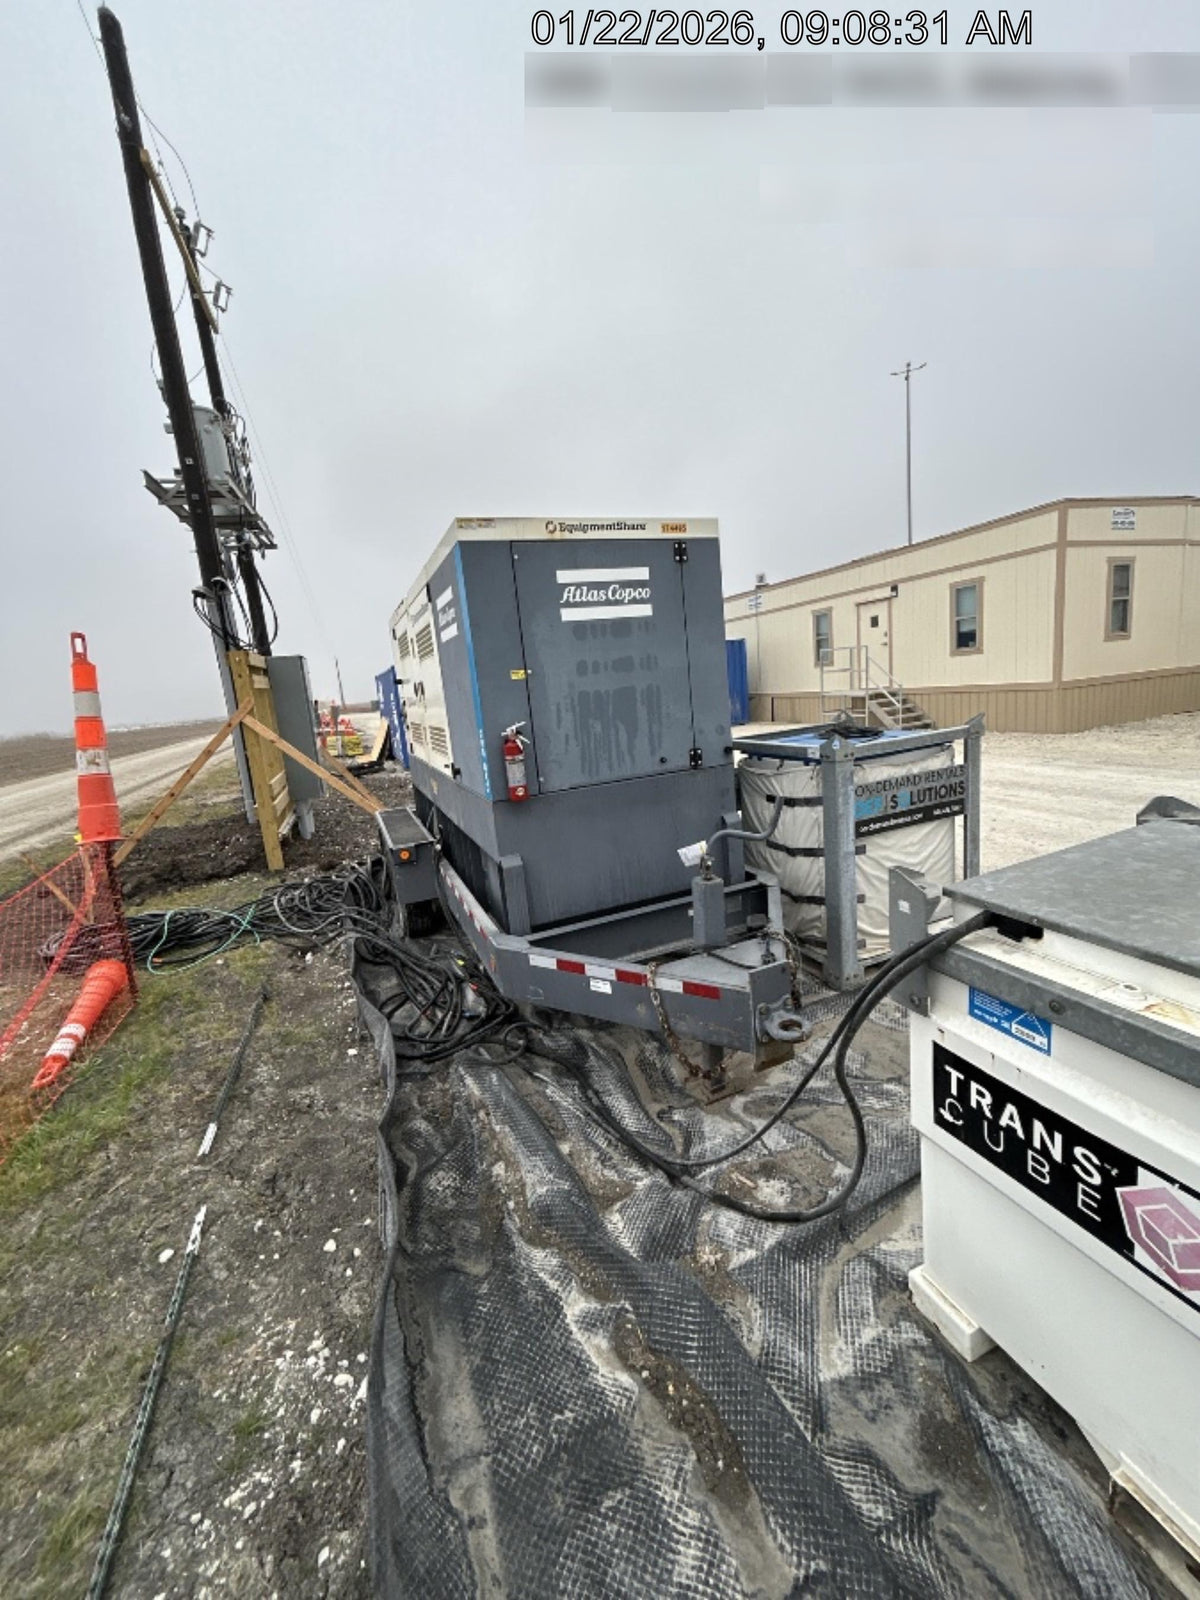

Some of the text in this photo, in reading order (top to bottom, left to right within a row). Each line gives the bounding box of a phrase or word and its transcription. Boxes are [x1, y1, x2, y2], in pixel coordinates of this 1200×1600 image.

[558, 521, 647, 534] EquipmentShare
[560, 584, 651, 603] Atlas Copco
[855, 774, 922, 797] ON-DEMAND
[944, 1064, 1102, 1186] TRANS
[939, 1098, 1102, 1222] CUBE
